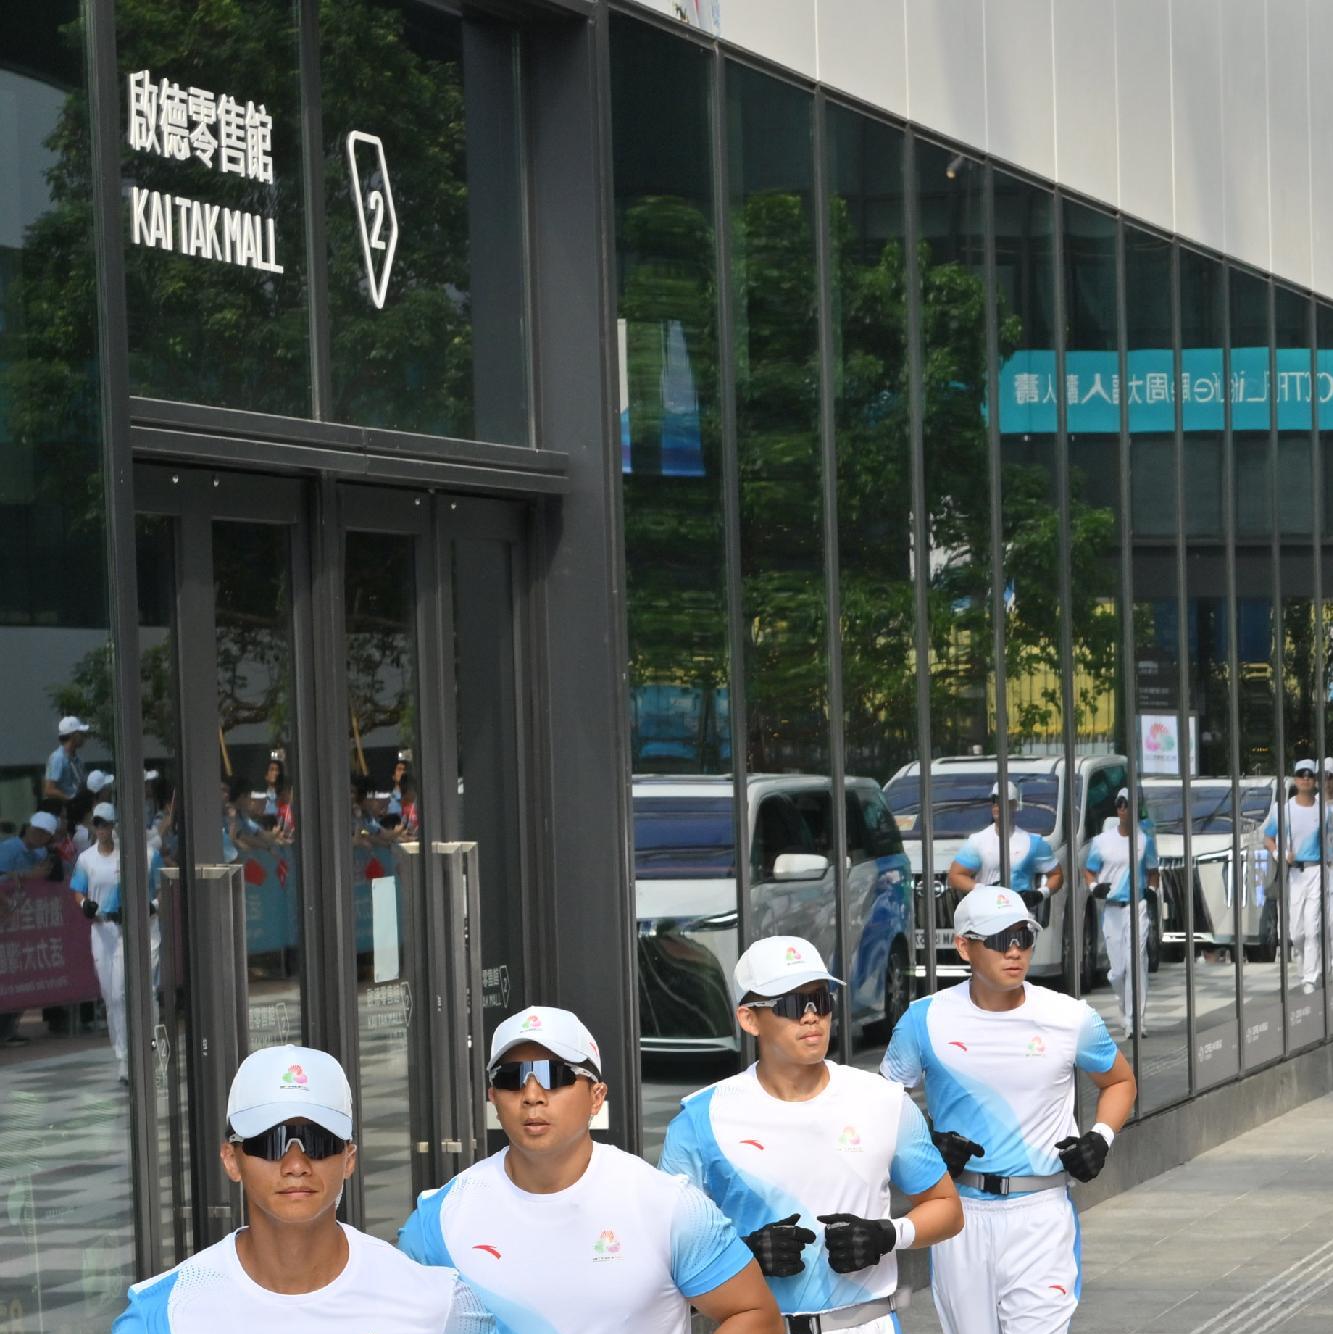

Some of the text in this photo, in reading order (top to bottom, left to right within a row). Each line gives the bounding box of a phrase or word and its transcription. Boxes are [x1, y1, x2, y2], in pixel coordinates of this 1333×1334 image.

[131, 186, 284, 274] KAI TAK MALL
[370, 190, 387, 251] 2
